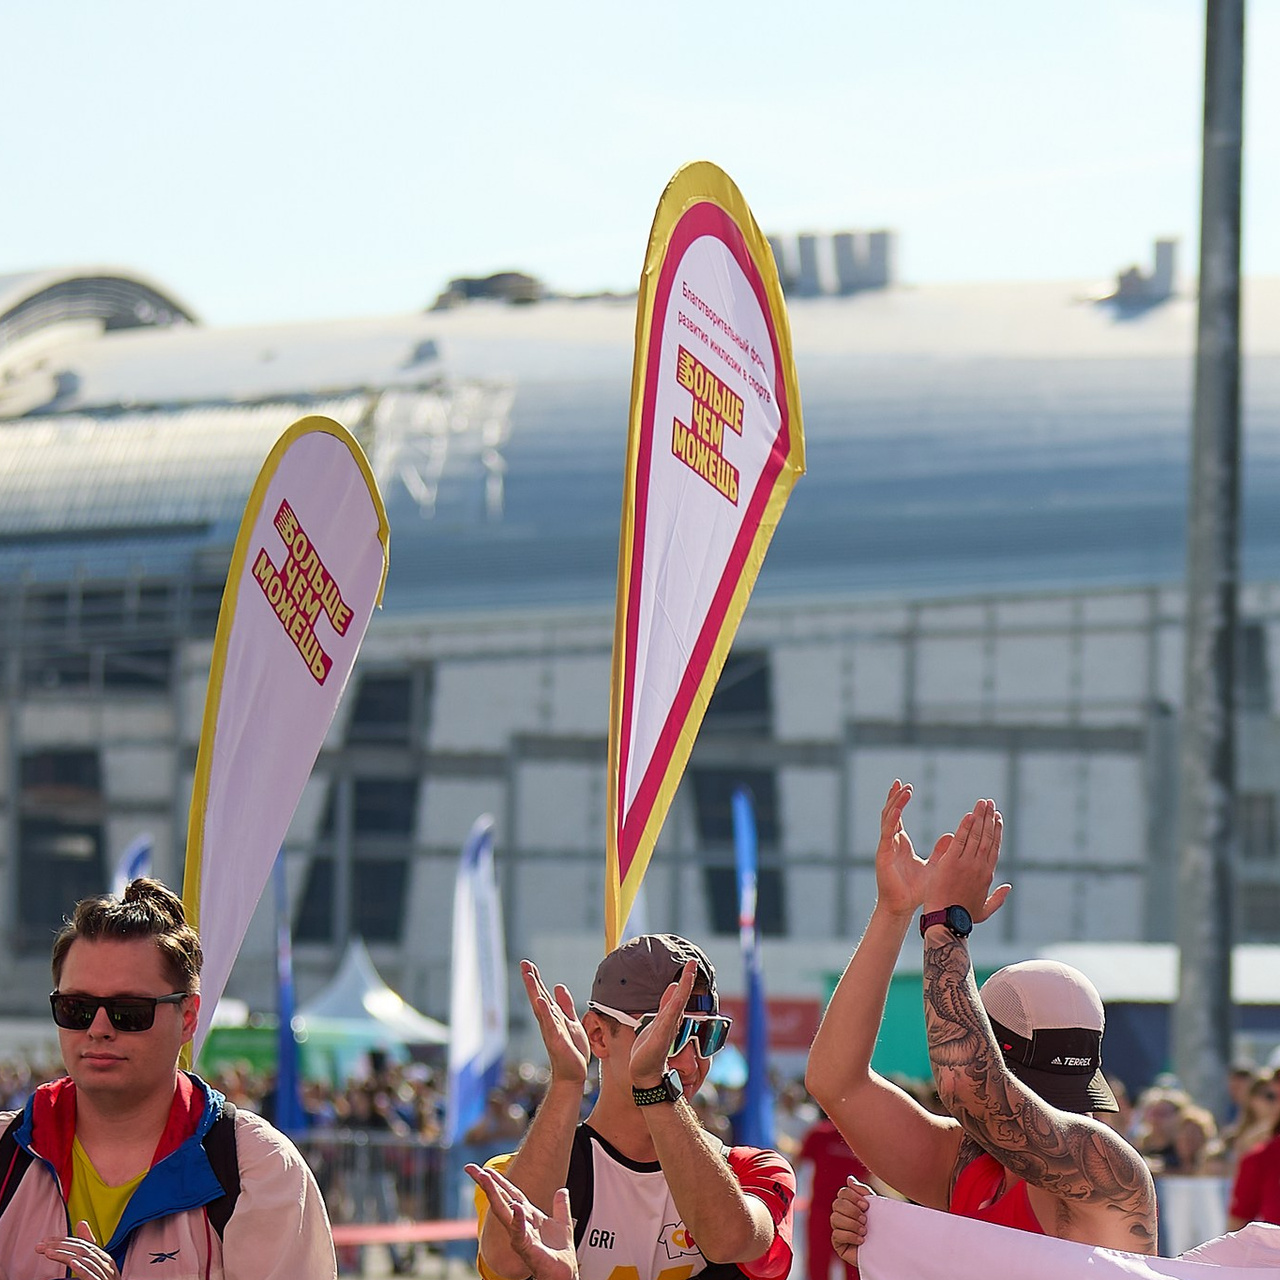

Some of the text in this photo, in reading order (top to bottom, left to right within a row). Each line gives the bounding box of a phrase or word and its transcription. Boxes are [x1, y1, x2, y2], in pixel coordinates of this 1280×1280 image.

[678, 311, 709, 346] развития
[710, 339, 742, 377] инклюзии
[748, 375, 772, 403] спорте
[682, 281, 749, 356] Благотворительный
[679, 351, 744, 434] БОЛЬШЕ
[693, 399, 724, 453] ЧЕМ
[673, 420, 739, 503] МОЖЕШЬ
[276, 506, 351, 634] БОЛЬШЕ
[285, 557, 322, 626] ЧЕМ
[253, 552, 327, 681] МОЖЕШЬ
[1063, 1057, 1092, 1067] TERREX
